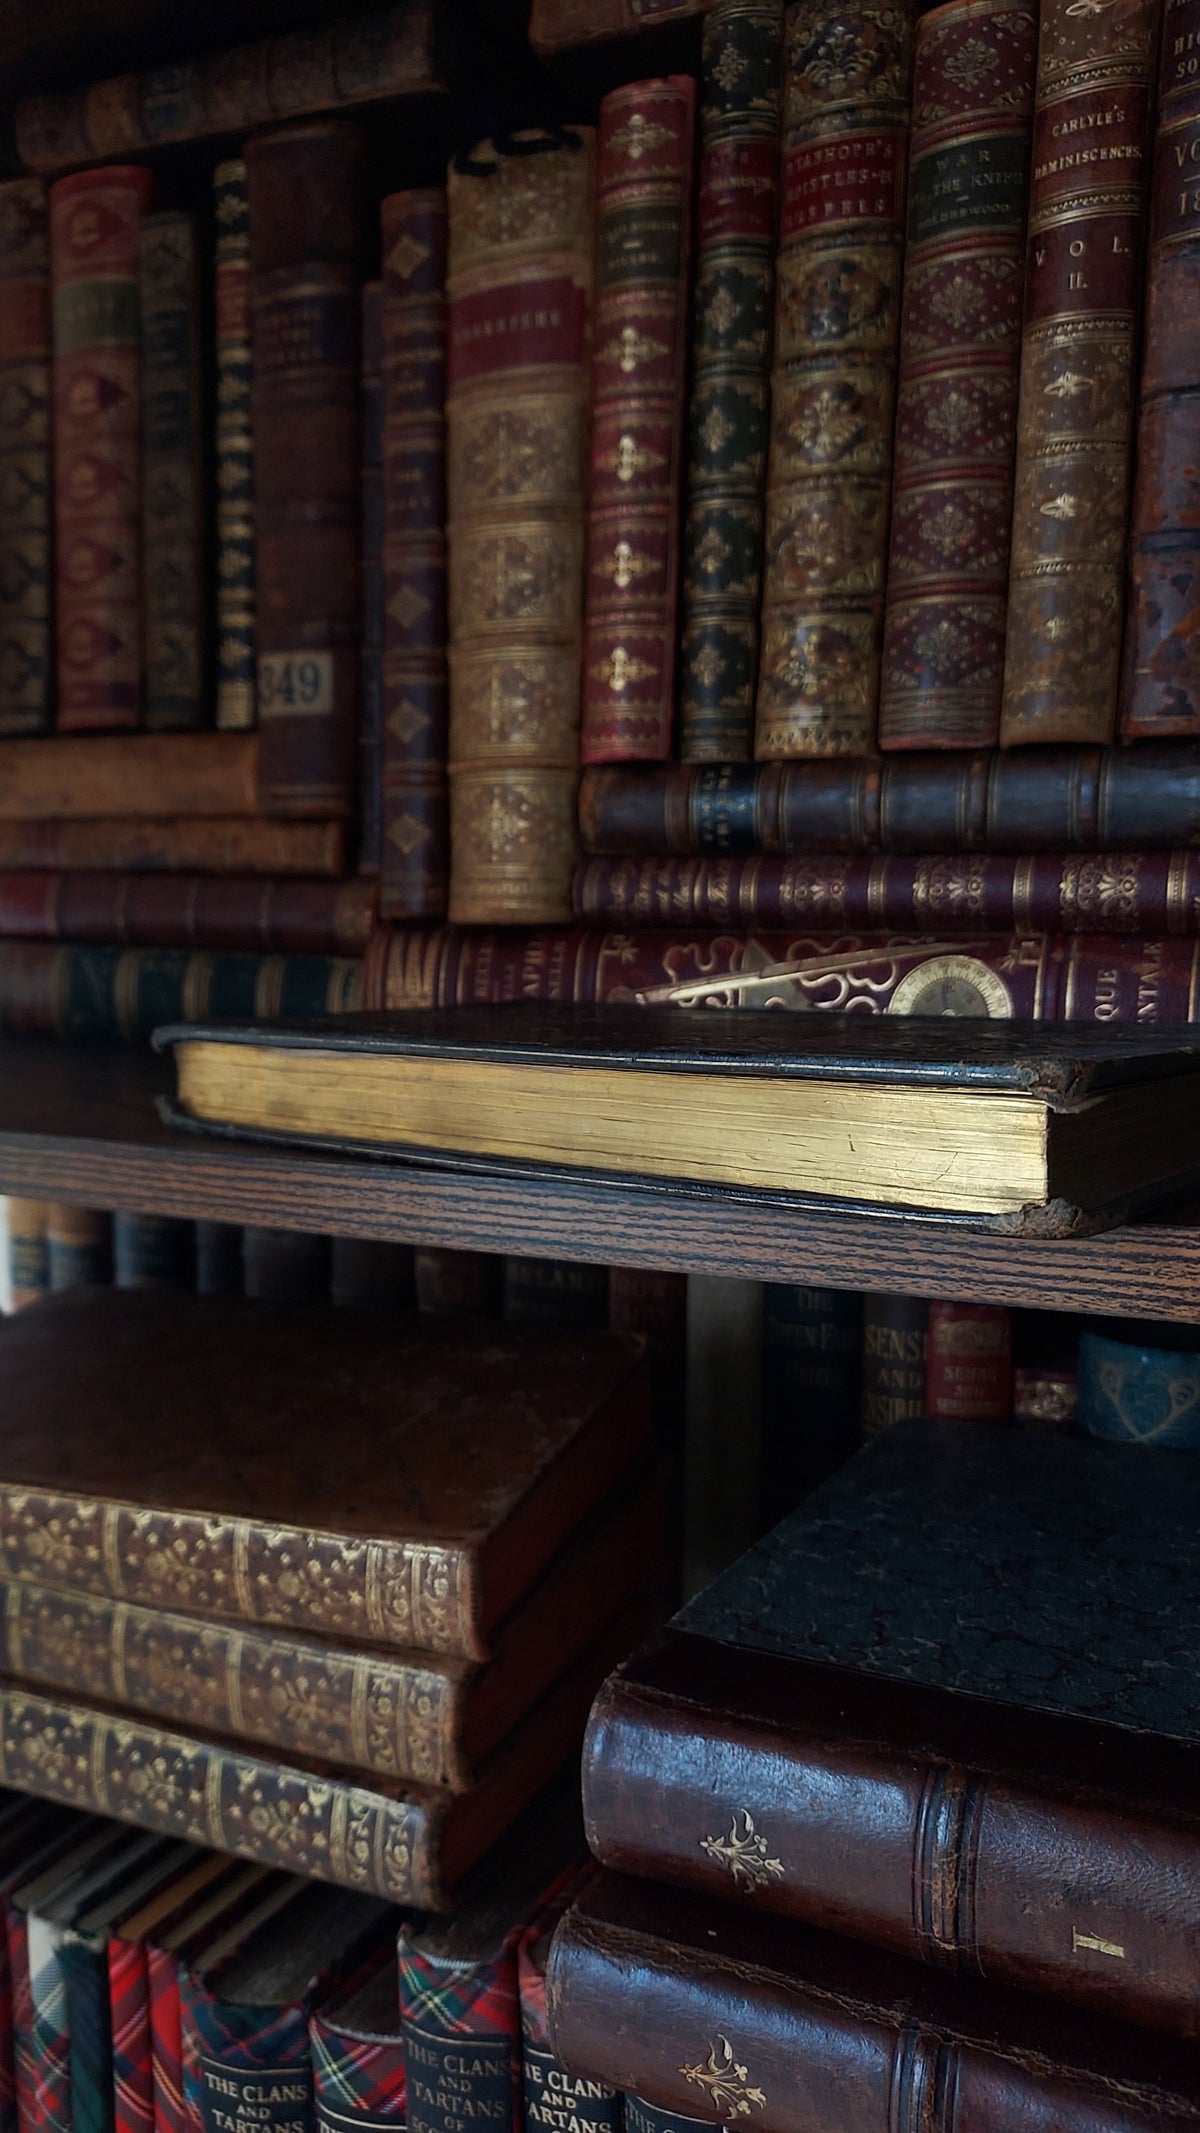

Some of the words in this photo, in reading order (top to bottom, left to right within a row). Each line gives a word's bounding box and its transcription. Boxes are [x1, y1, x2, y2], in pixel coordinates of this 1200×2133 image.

[1174, 31, 1200, 56] HI
[1051, 104, 1126, 138] CARLYLE'S
[932, 178, 962, 197] THE
[876, 1367, 921, 1390] AND
[406, 2037, 439, 2069] THE
[443, 2054, 509, 2077] CLANS
[204, 2071, 239, 2099] THE
[241, 2084, 308, 2103] CLANS
[437, 2075, 473, 2093] AND
[411, 2078, 505, 2118] TARTANS
[541, 2090, 578, 2109] AND
[211, 2108, 304, 2133] TARTANS
[236, 2104, 273, 2120] AND
[443, 2115, 466, 2132] OF
[525, 2096, 613, 2133] ARTANS
